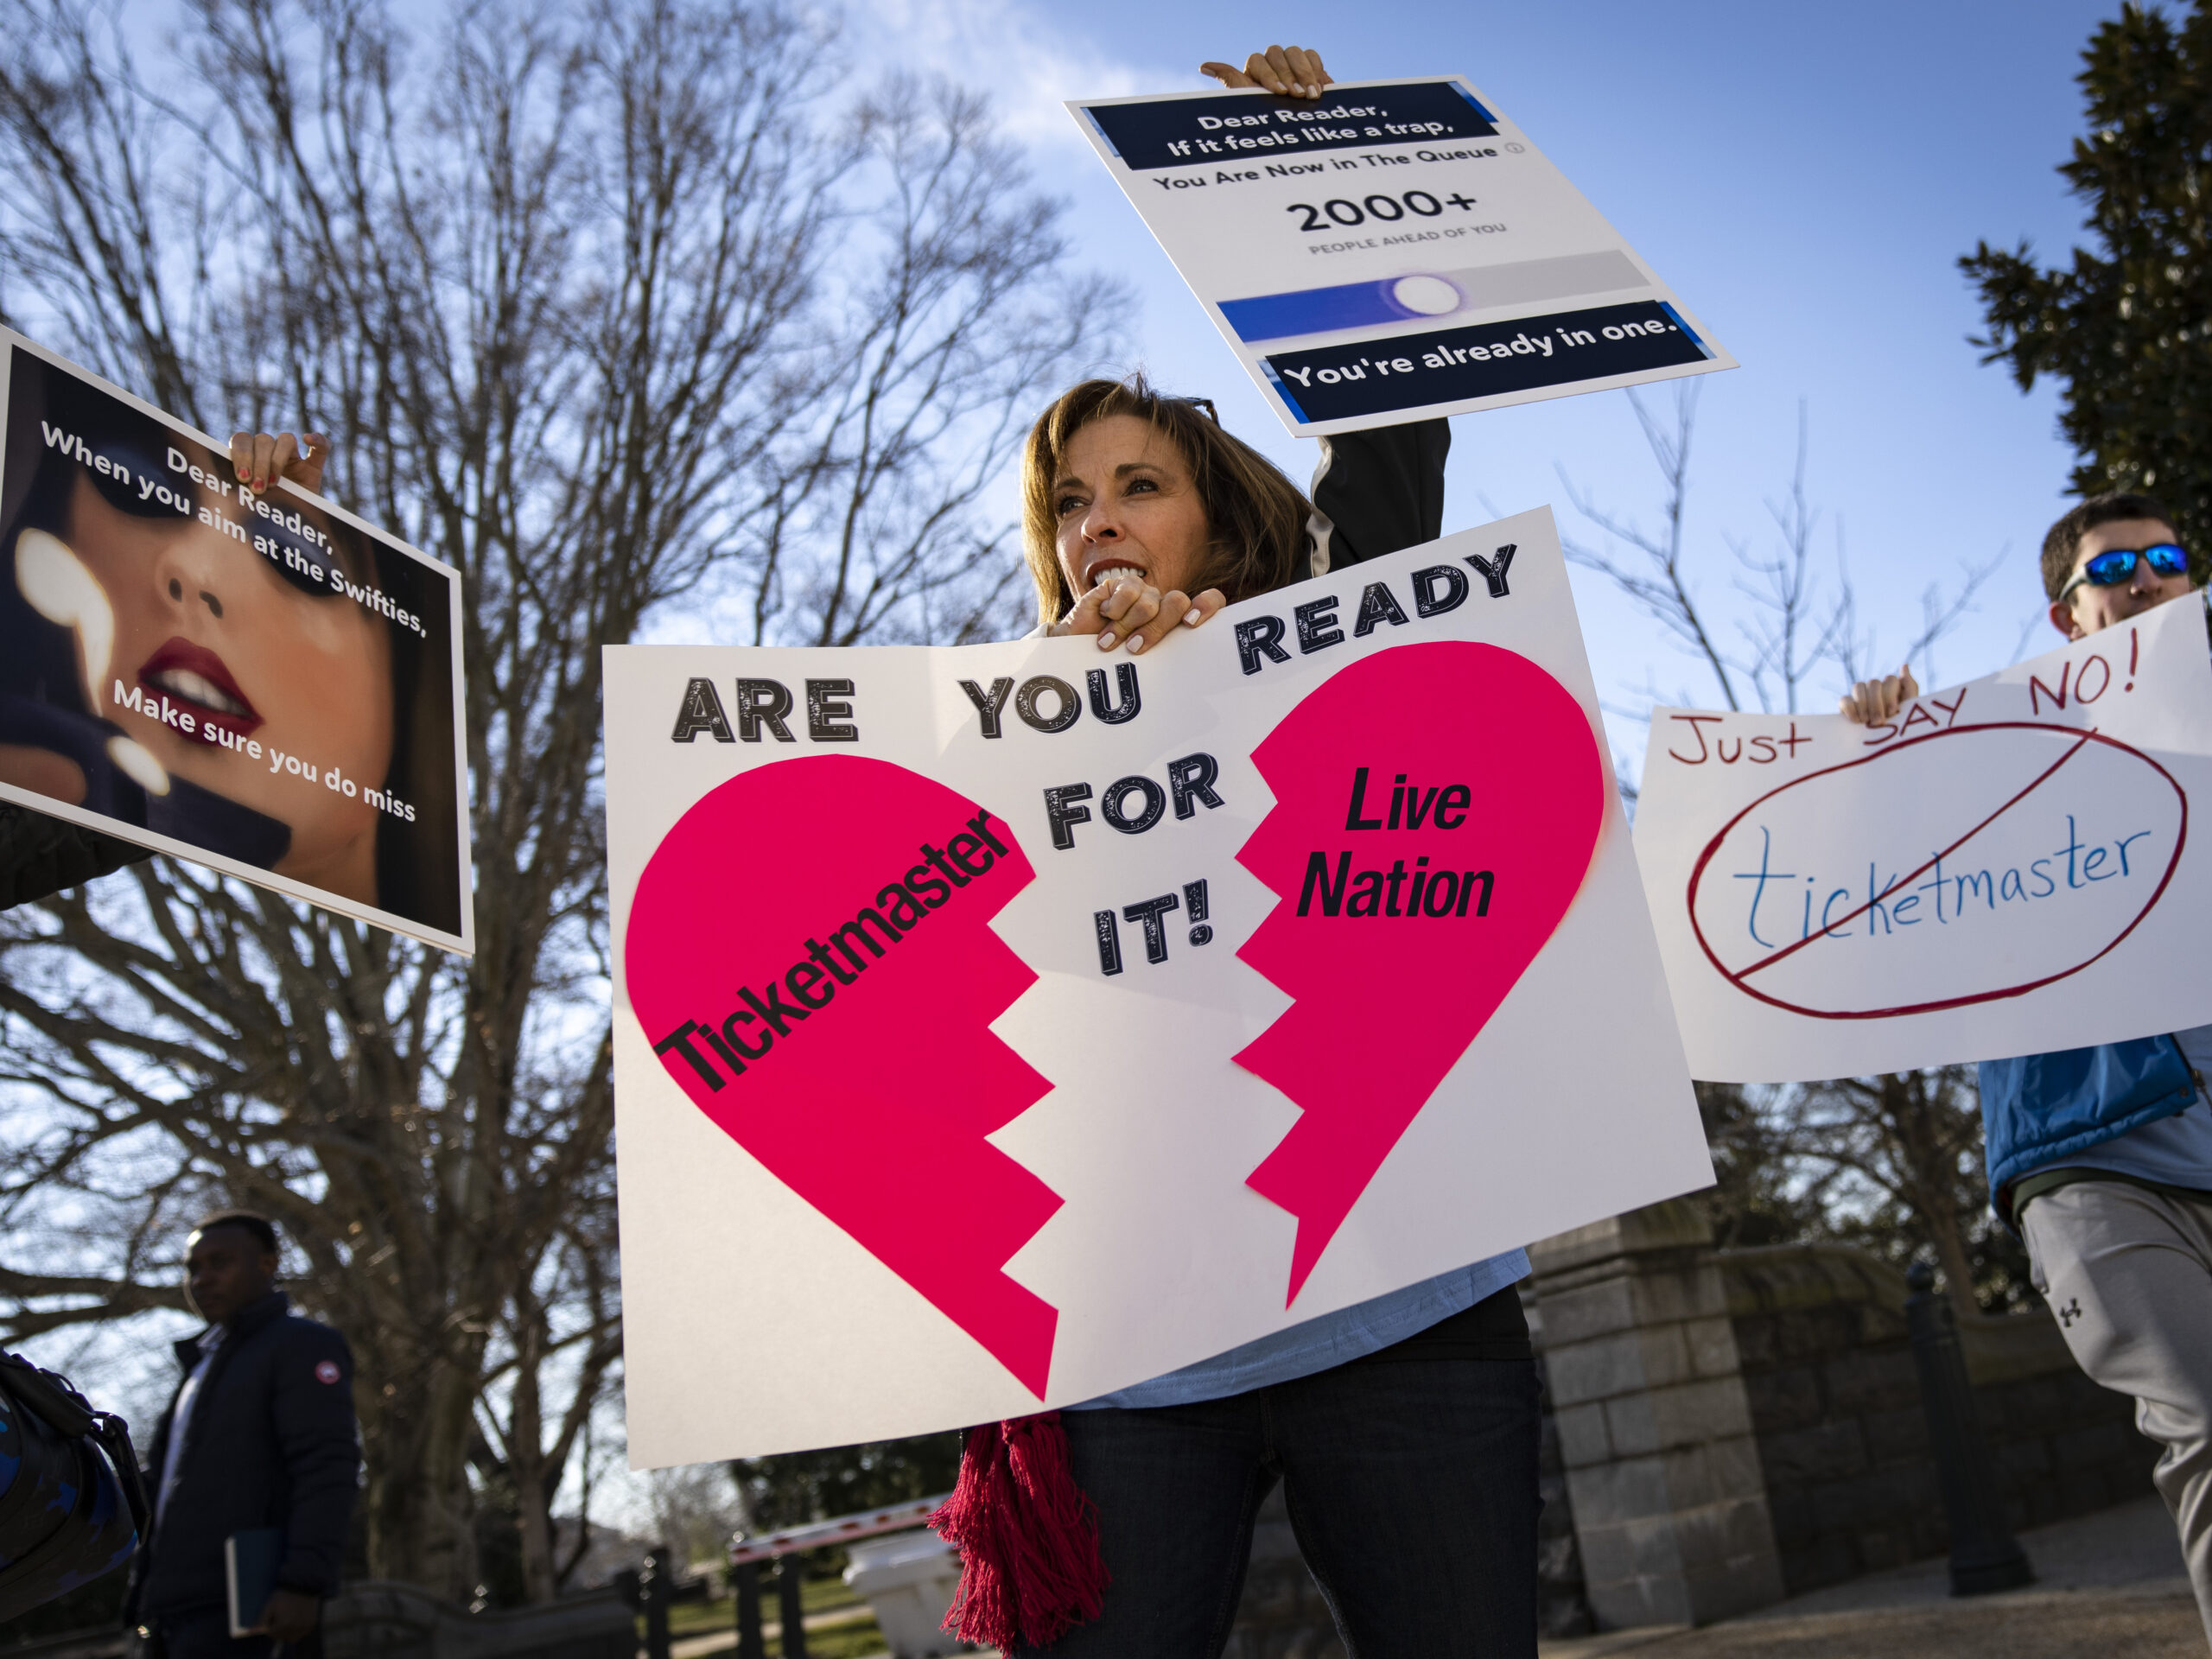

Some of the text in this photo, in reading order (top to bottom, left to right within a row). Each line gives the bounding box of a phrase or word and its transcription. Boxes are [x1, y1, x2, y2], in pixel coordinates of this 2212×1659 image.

[1167, 119, 1454, 156] If it feels like a trap,
[1198, 103, 1388, 130] Dear Reader,
[1154, 146, 1498, 191] You Are Now in The Queue
[1287, 190, 1478, 232] 2000+
[1308, 222, 1508, 255] PEOPLE AHEAD OF YOU
[1284, 318, 1677, 388] You're already in one.
[41, 420, 428, 638] When you aim at the Swifties,
[168, 447, 334, 555] Dear Reader,
[671, 543, 1518, 743] ARE YOU READY
[2029, 627, 2139, 715] NO!
[113, 678, 416, 822] Make sure you do miss
[1042, 752, 1226, 851] FOR
[1344, 766, 1471, 831] Live
[1296, 850, 1495, 918] Nation
[1733, 815, 2152, 948] ticketmaster
[652, 809, 1010, 1093] Ticketmaster
[1093, 878, 1214, 977] IT!
